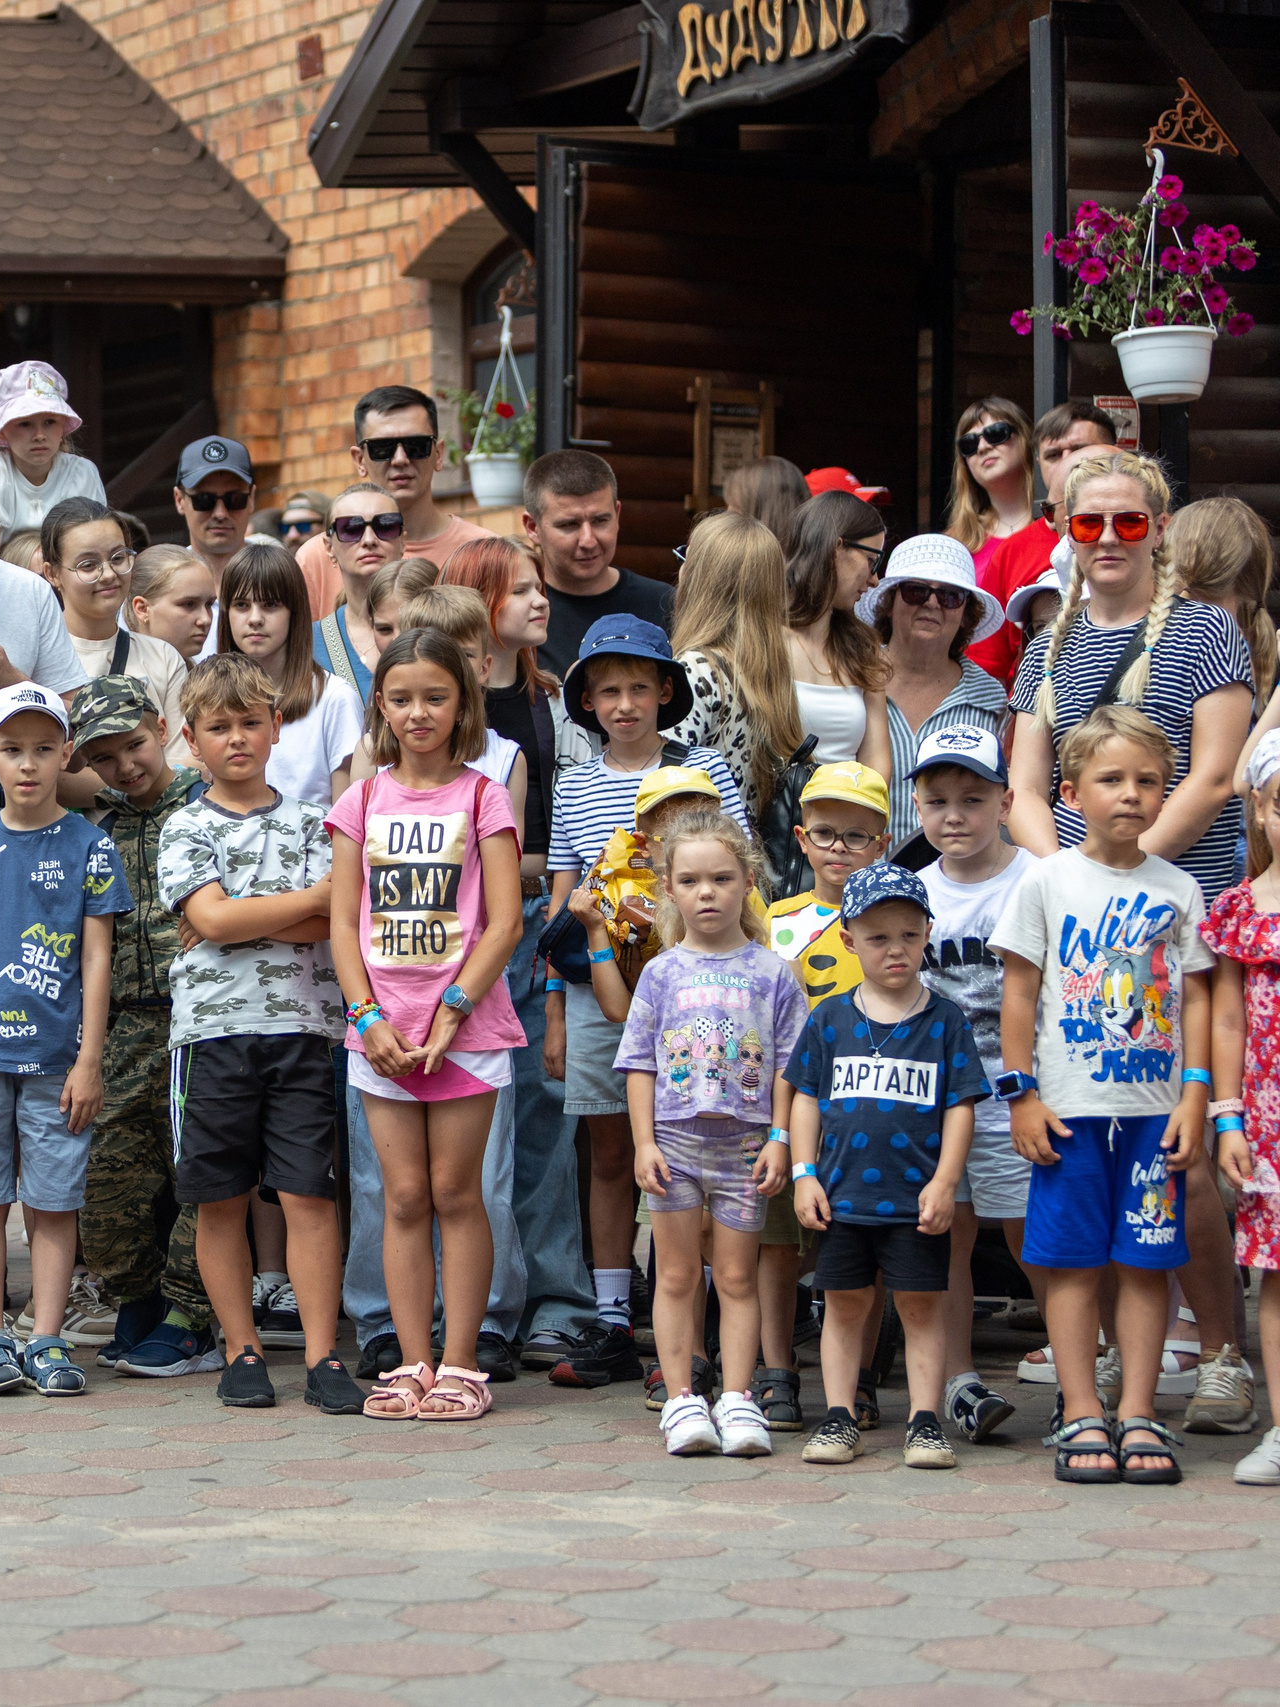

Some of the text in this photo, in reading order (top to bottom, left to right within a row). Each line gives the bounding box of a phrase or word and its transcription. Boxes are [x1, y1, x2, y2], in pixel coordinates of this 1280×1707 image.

[388, 821, 445, 855] DAD
[30, 869, 65, 882] RULES
[38, 860, 60, 870] HERE
[379, 868, 453, 907] IS MY
[21, 922, 76, 958] DAY
[382, 919, 447, 956] HERO
[21, 942, 60, 972] THE
[693, 973, 750, 988] FEELING
[0, 1010, 28, 1022] FUN
[1059, 1017, 1104, 1043] TOM
[18, 1063, 40, 1073] HERE
[1090, 1048, 1176, 1083] JERRY
[833, 1063, 930, 1098] CAPTAIN
[1136, 1227, 1177, 1245] JERRY
